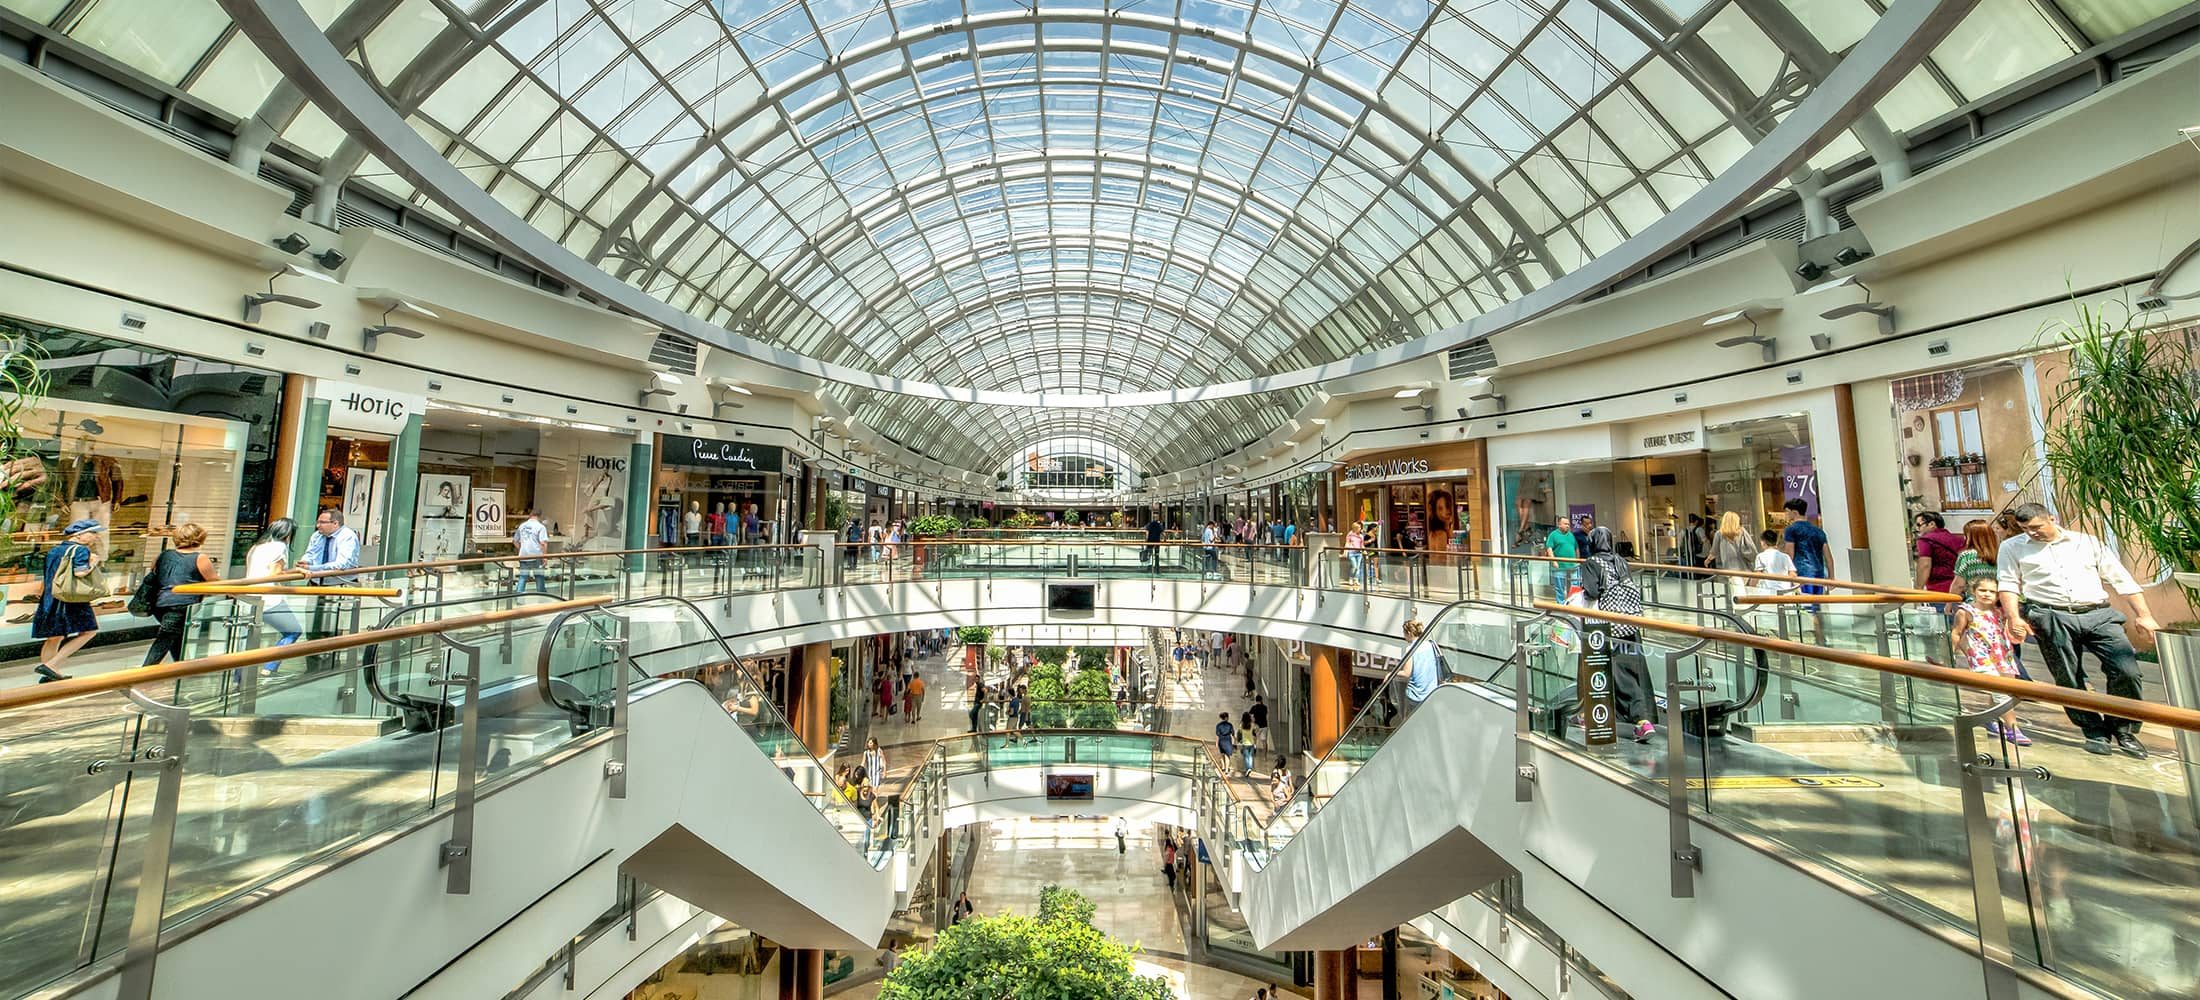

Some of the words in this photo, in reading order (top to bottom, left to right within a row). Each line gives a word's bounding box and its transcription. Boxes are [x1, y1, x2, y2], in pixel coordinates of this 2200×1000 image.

[721, 444, 756, 469] Cardin
[1388, 457, 1429, 475] Works
[476, 503, 501, 523] 60
